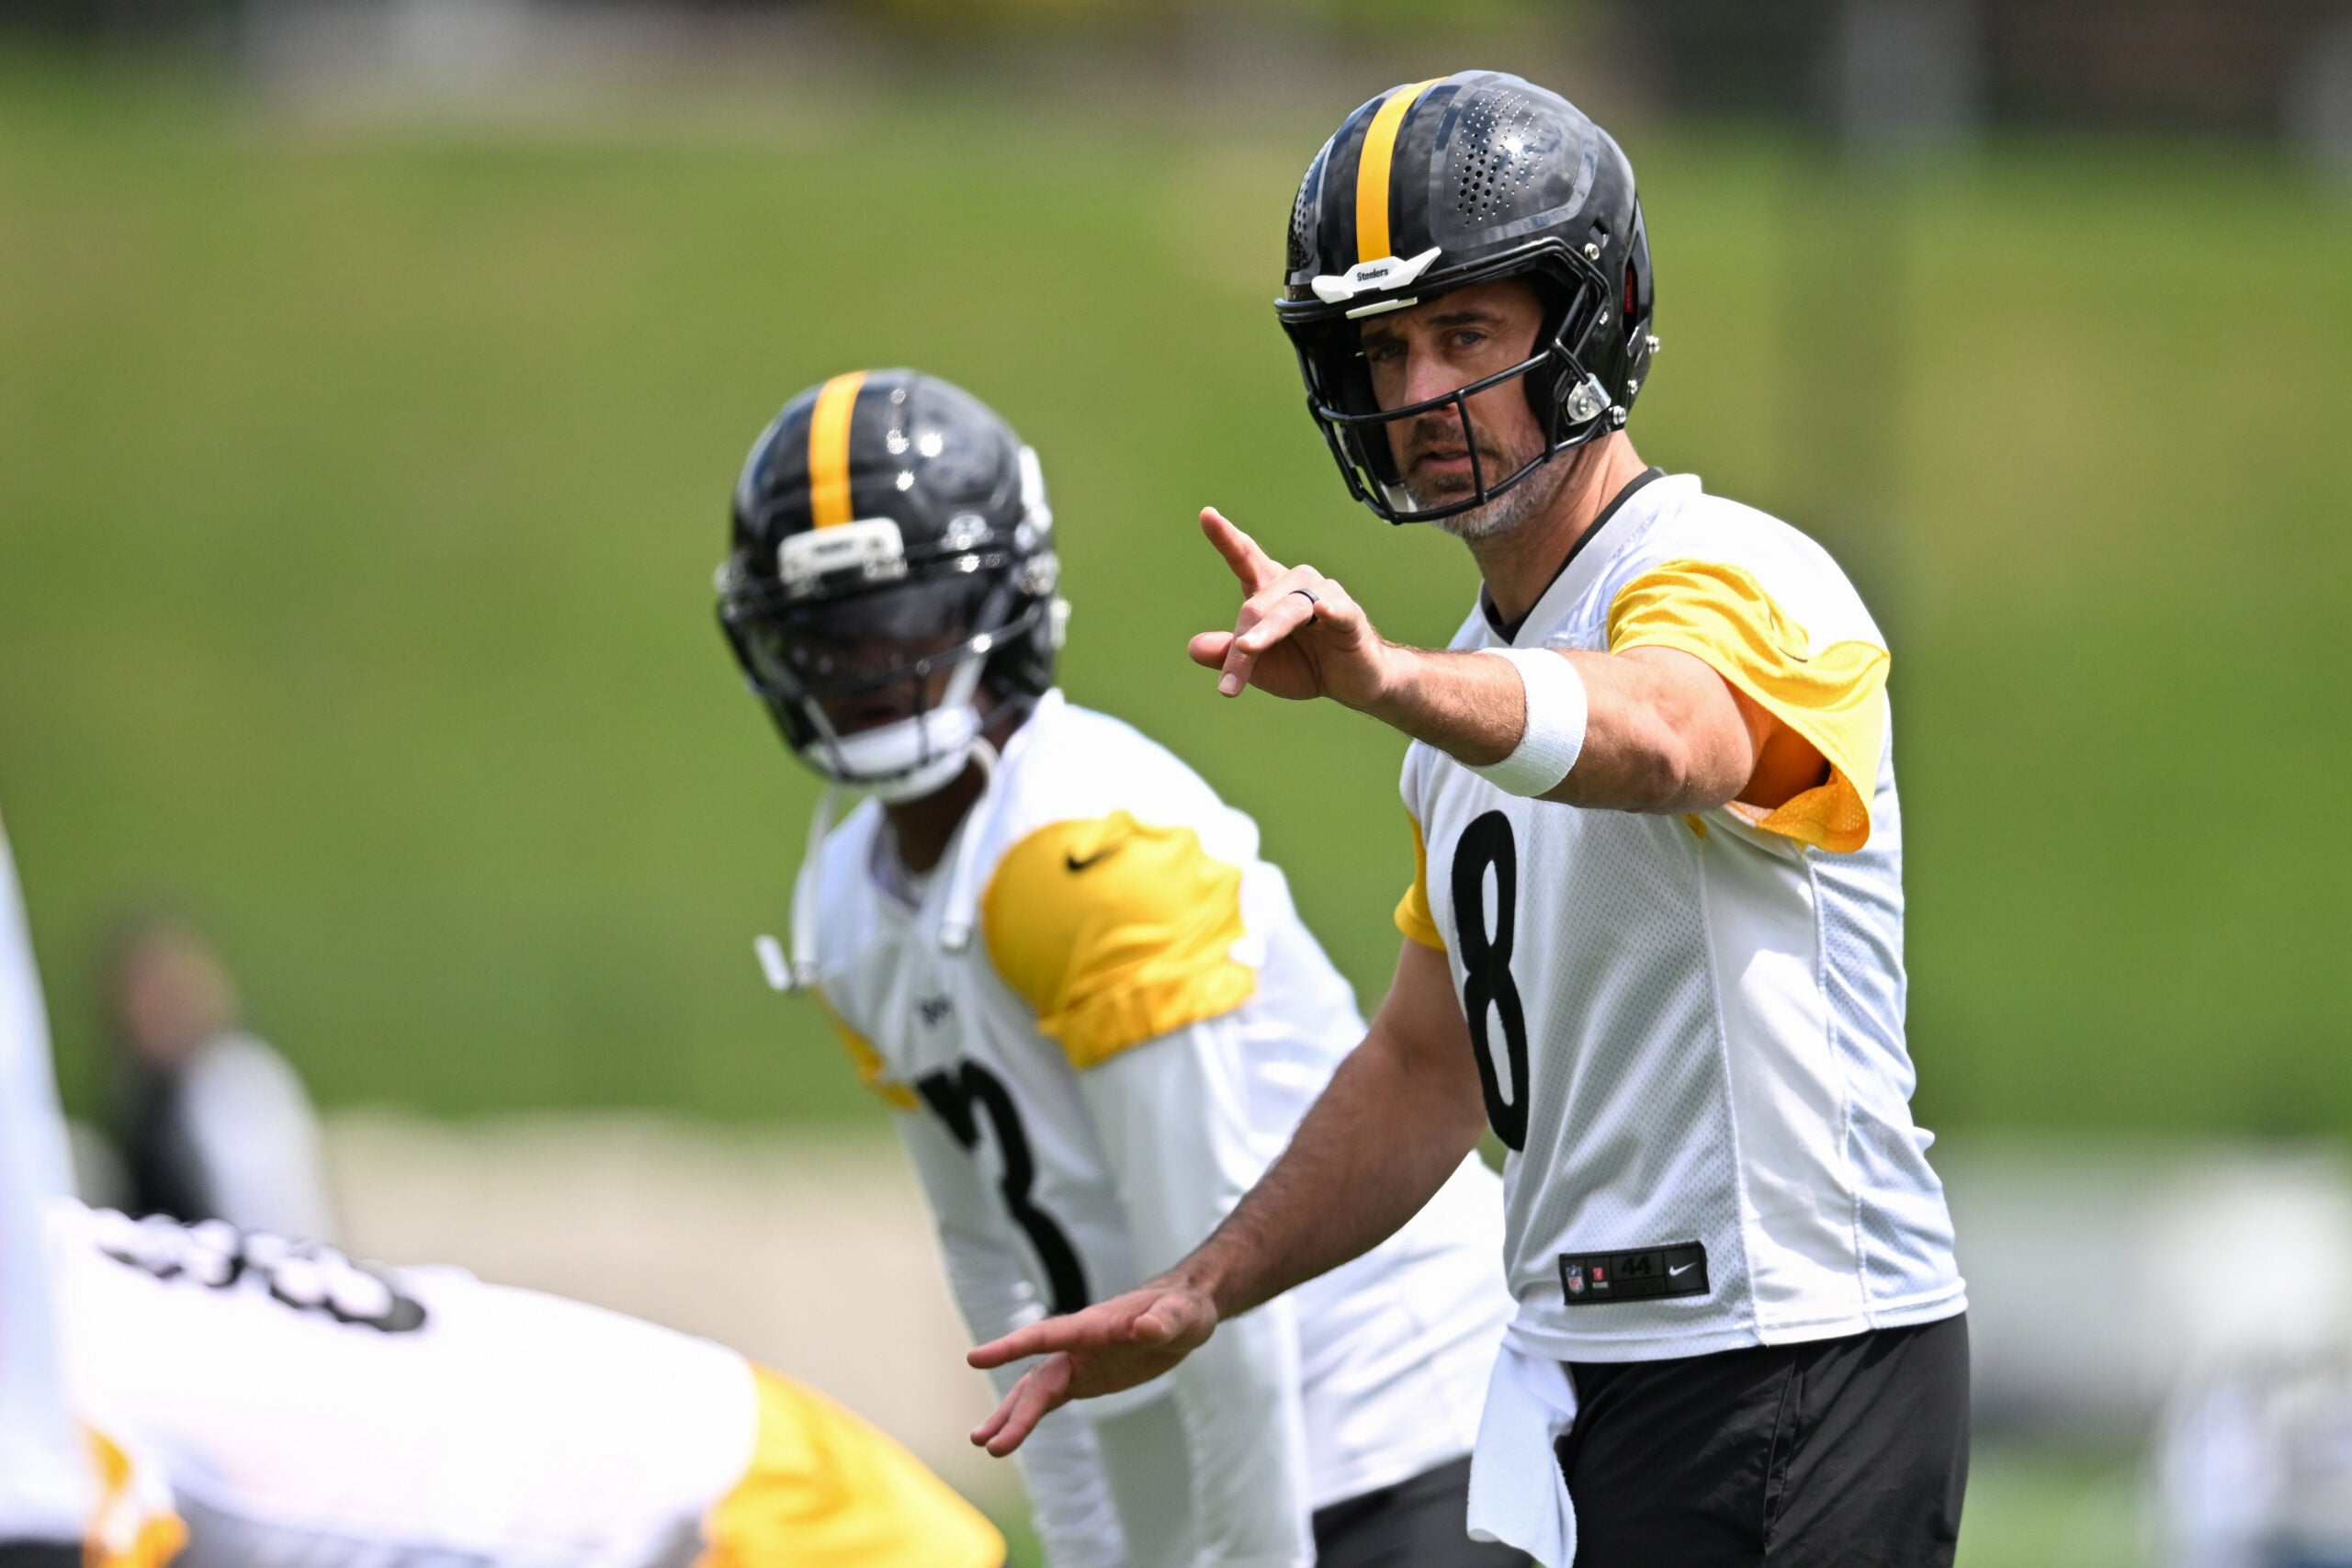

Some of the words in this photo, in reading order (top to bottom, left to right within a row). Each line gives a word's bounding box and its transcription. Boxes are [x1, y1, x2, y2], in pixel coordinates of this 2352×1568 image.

[1357, 267, 1389, 282] Steelers
[1452, 809, 1530, 1152] 8
[1620, 1256, 1653, 1276] 44
